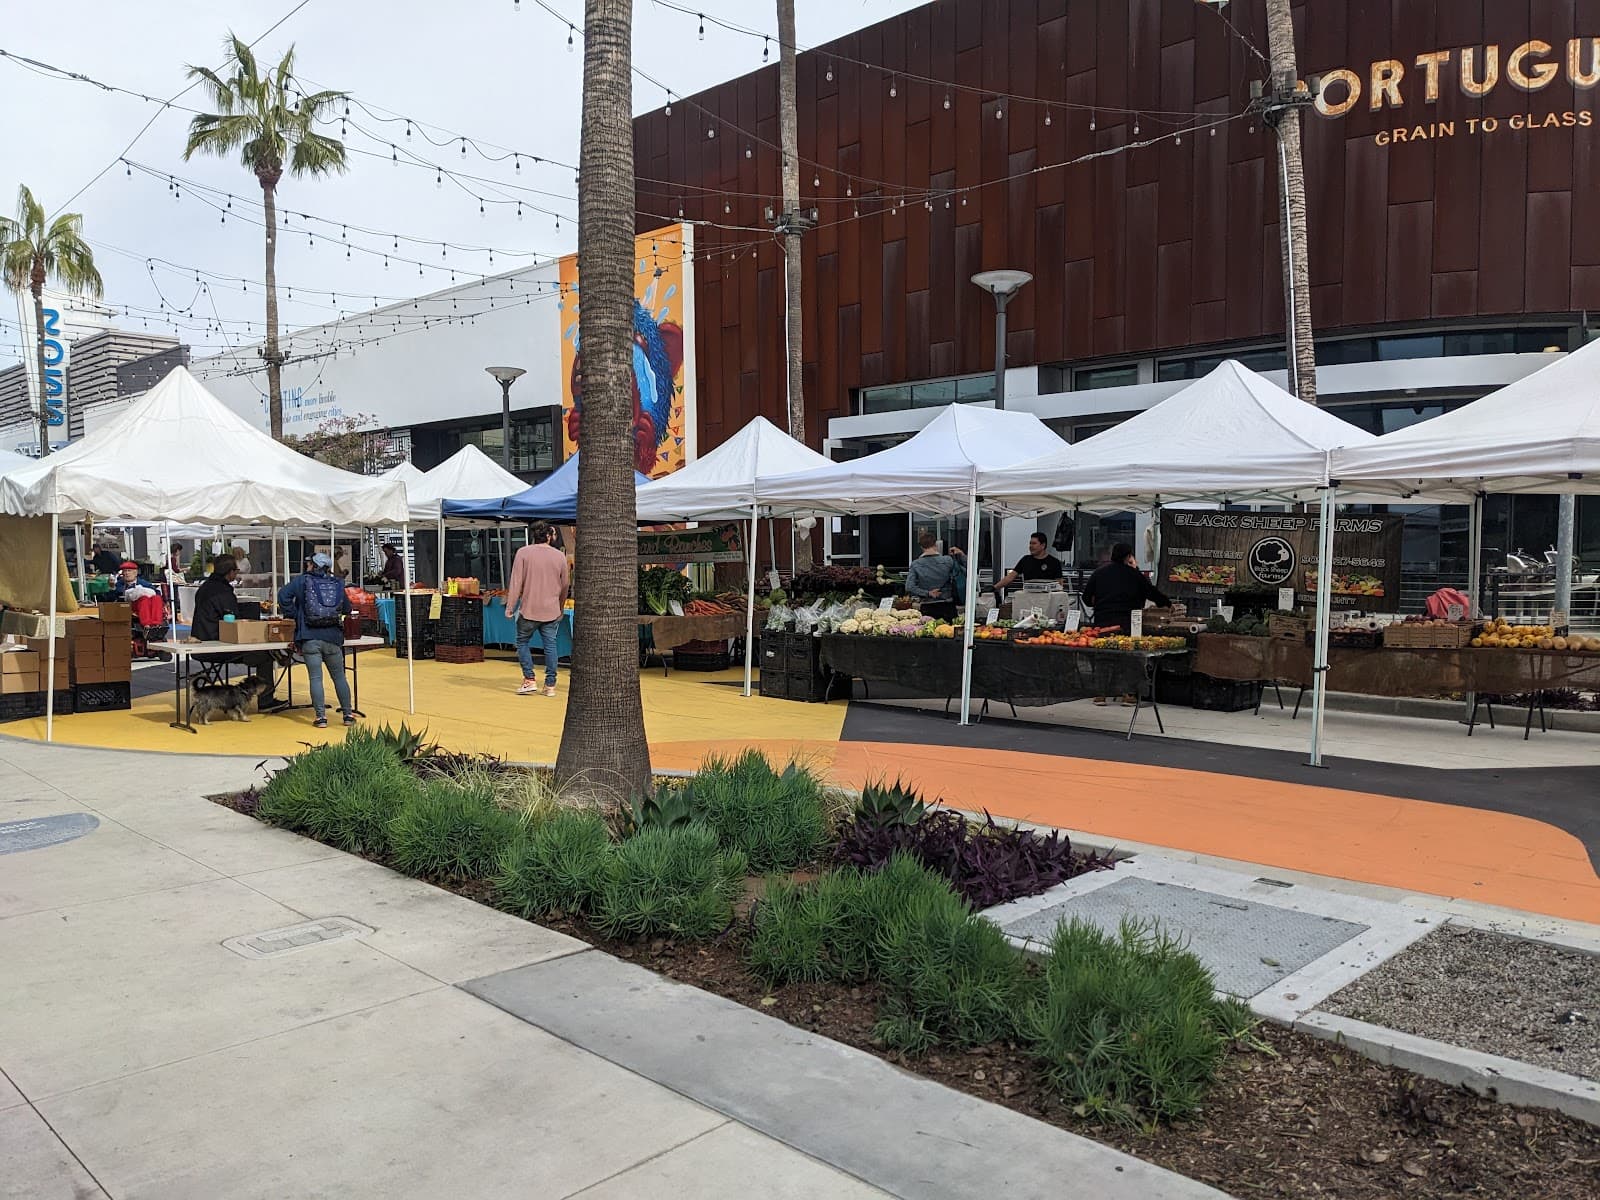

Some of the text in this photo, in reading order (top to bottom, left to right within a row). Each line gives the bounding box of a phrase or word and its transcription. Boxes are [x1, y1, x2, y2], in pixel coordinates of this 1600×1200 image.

[1297, 37, 1600, 117] ORTUGU
[1374, 110, 1593, 147] GRAIN TO GLASS
[1174, 513, 1384, 533] BLACK SHEEP FRMS
